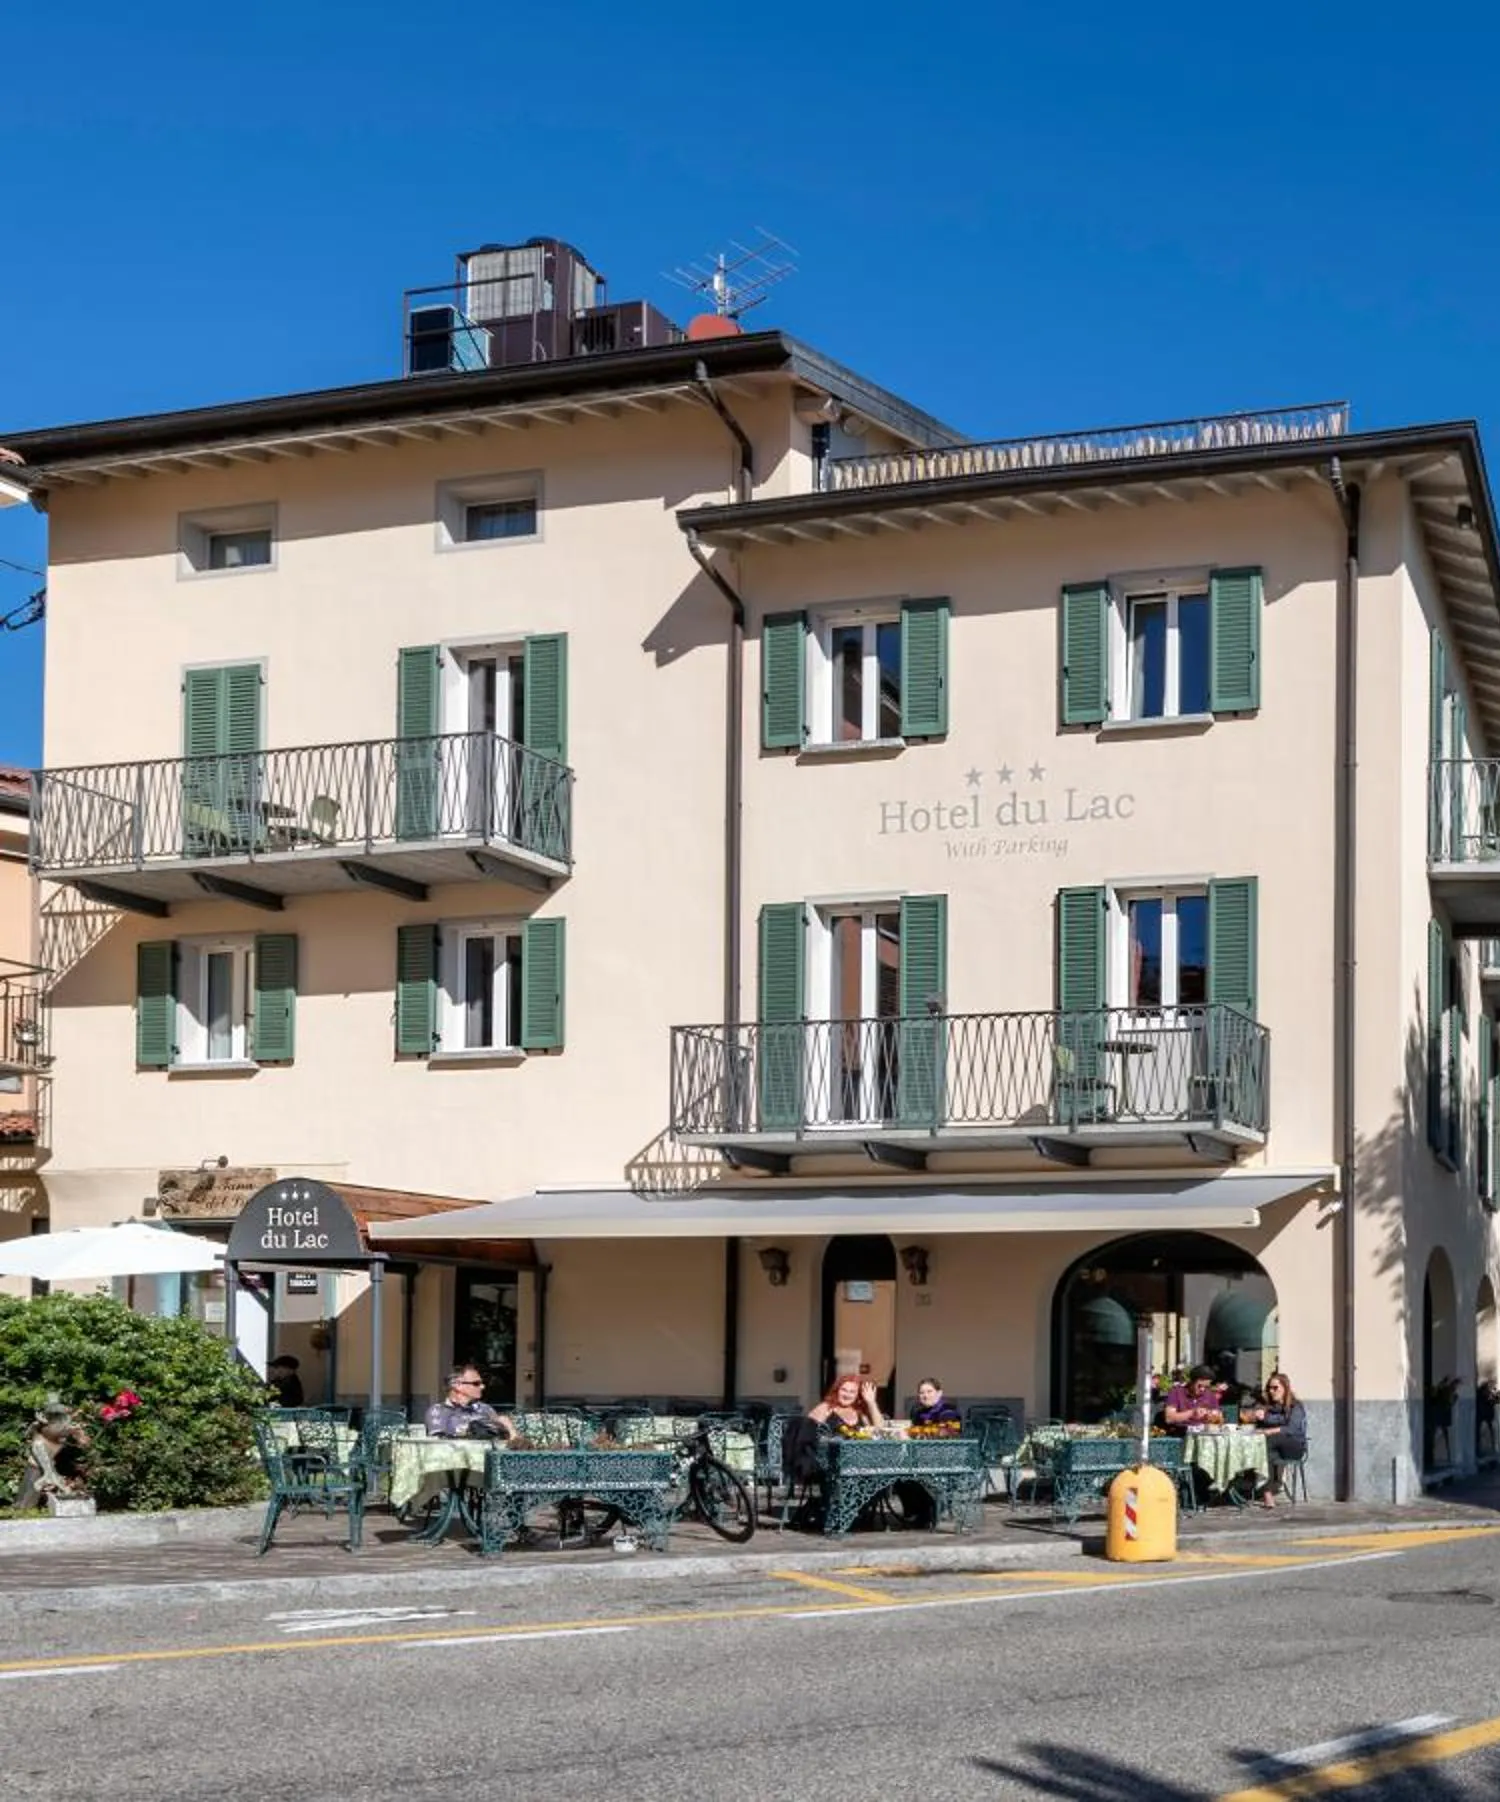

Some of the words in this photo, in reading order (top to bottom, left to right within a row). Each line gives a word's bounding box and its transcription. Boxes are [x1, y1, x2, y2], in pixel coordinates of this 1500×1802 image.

[878, 795, 981, 835] Hotel
[995, 791, 1047, 827] du
[1064, 788, 1136, 822] Lac
[945, 838, 987, 859] With
[992, 834, 1069, 858] Parking
[267, 1207, 319, 1227] Hotel
[261, 1230, 287, 1248] du
[293, 1229, 329, 1248] Lac
